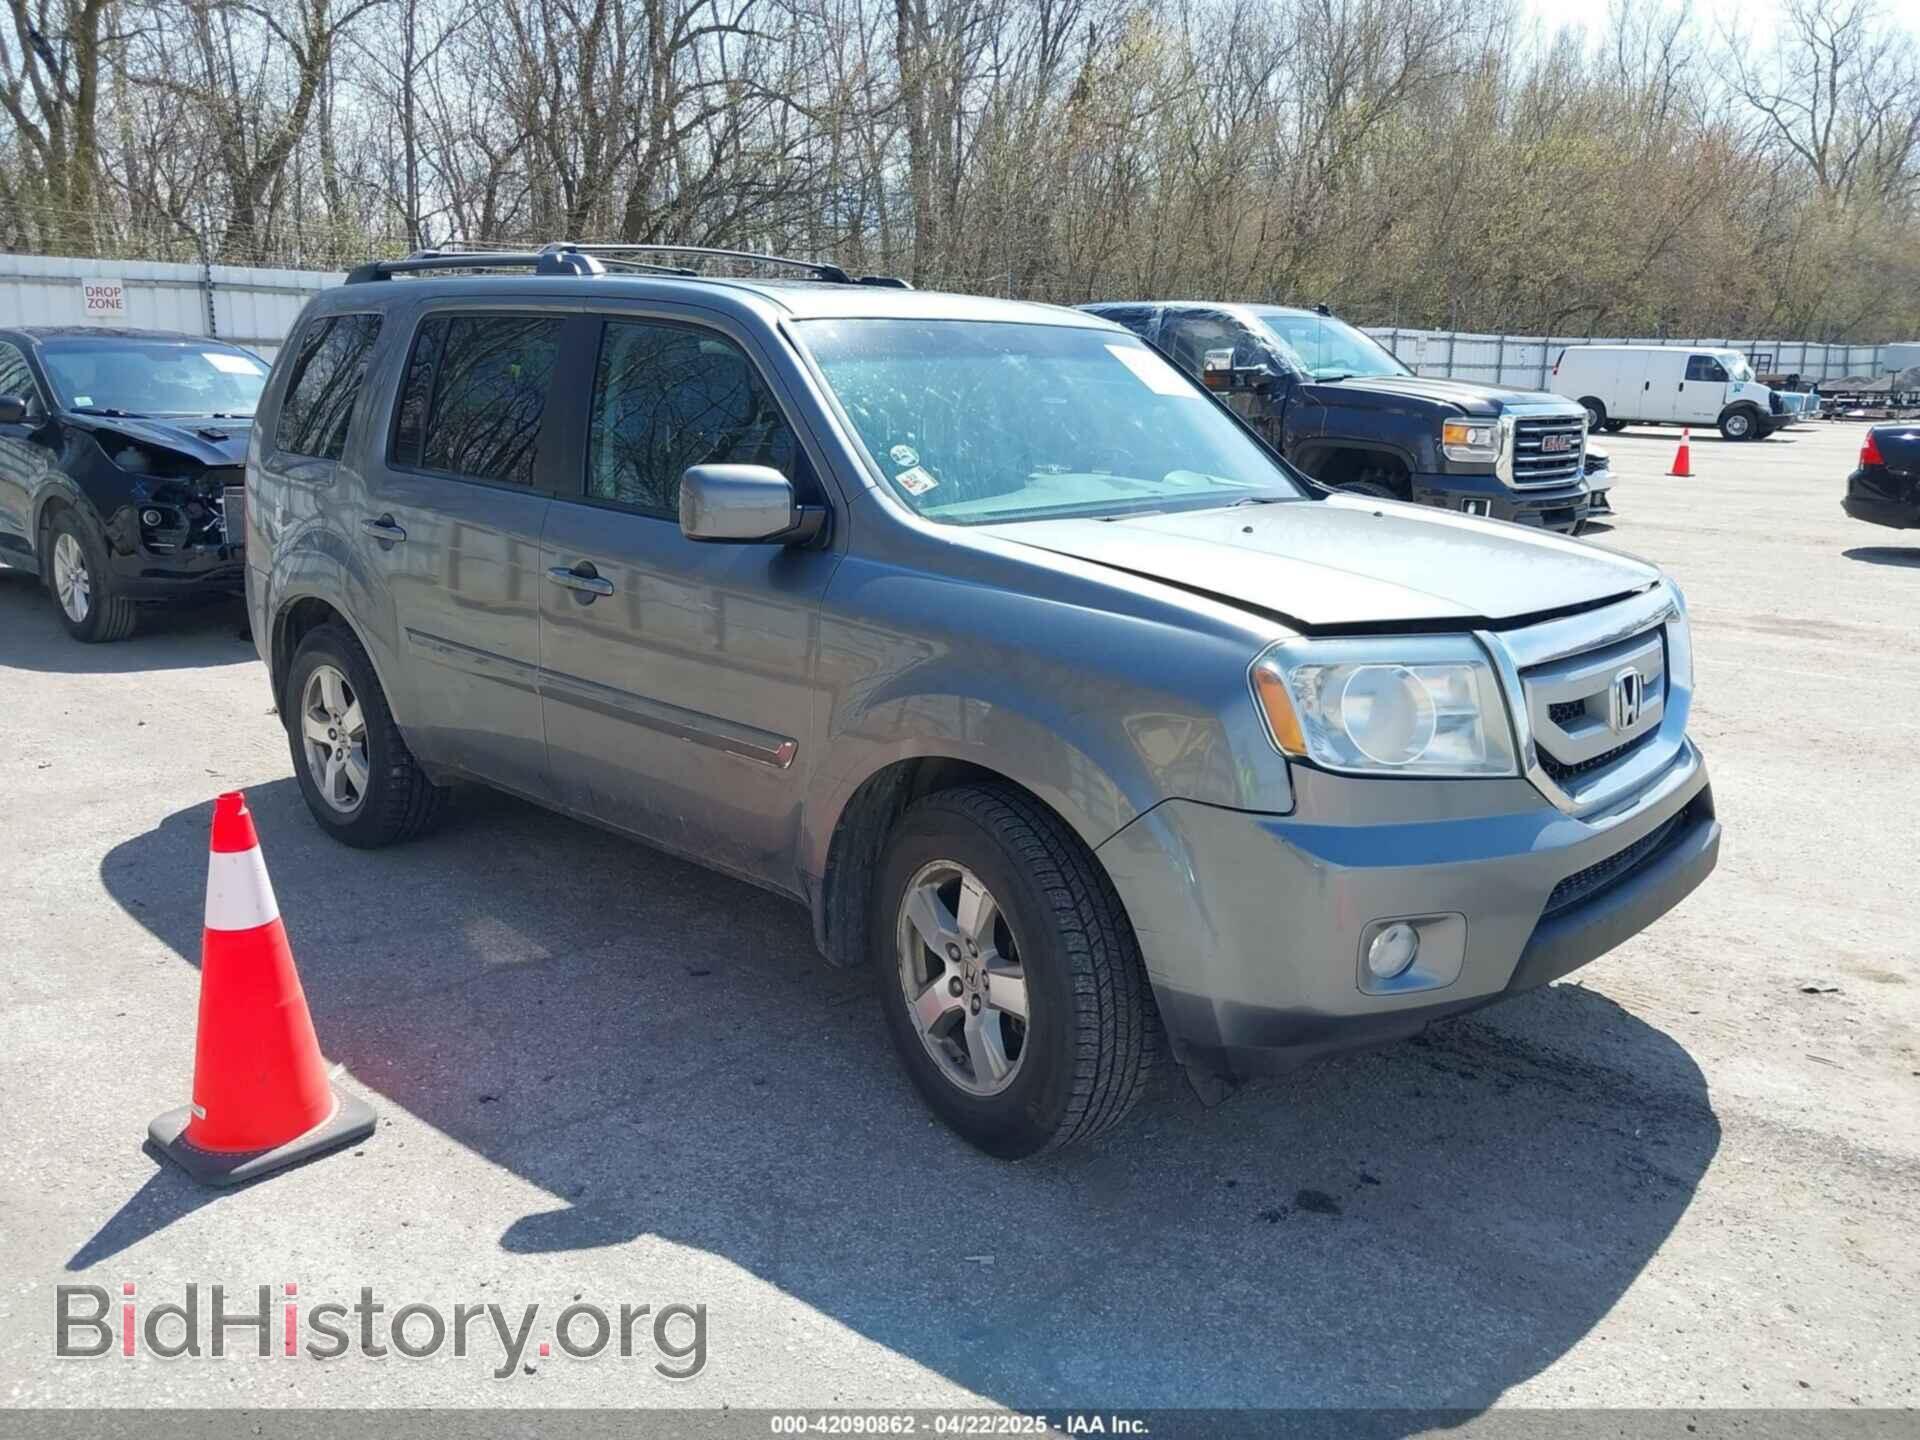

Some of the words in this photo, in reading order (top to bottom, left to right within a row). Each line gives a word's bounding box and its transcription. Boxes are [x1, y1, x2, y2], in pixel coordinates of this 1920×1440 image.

[85, 286, 121, 297] DROP
[87, 298, 122, 309] ZONE
[1542, 434, 1573, 452] GMC
